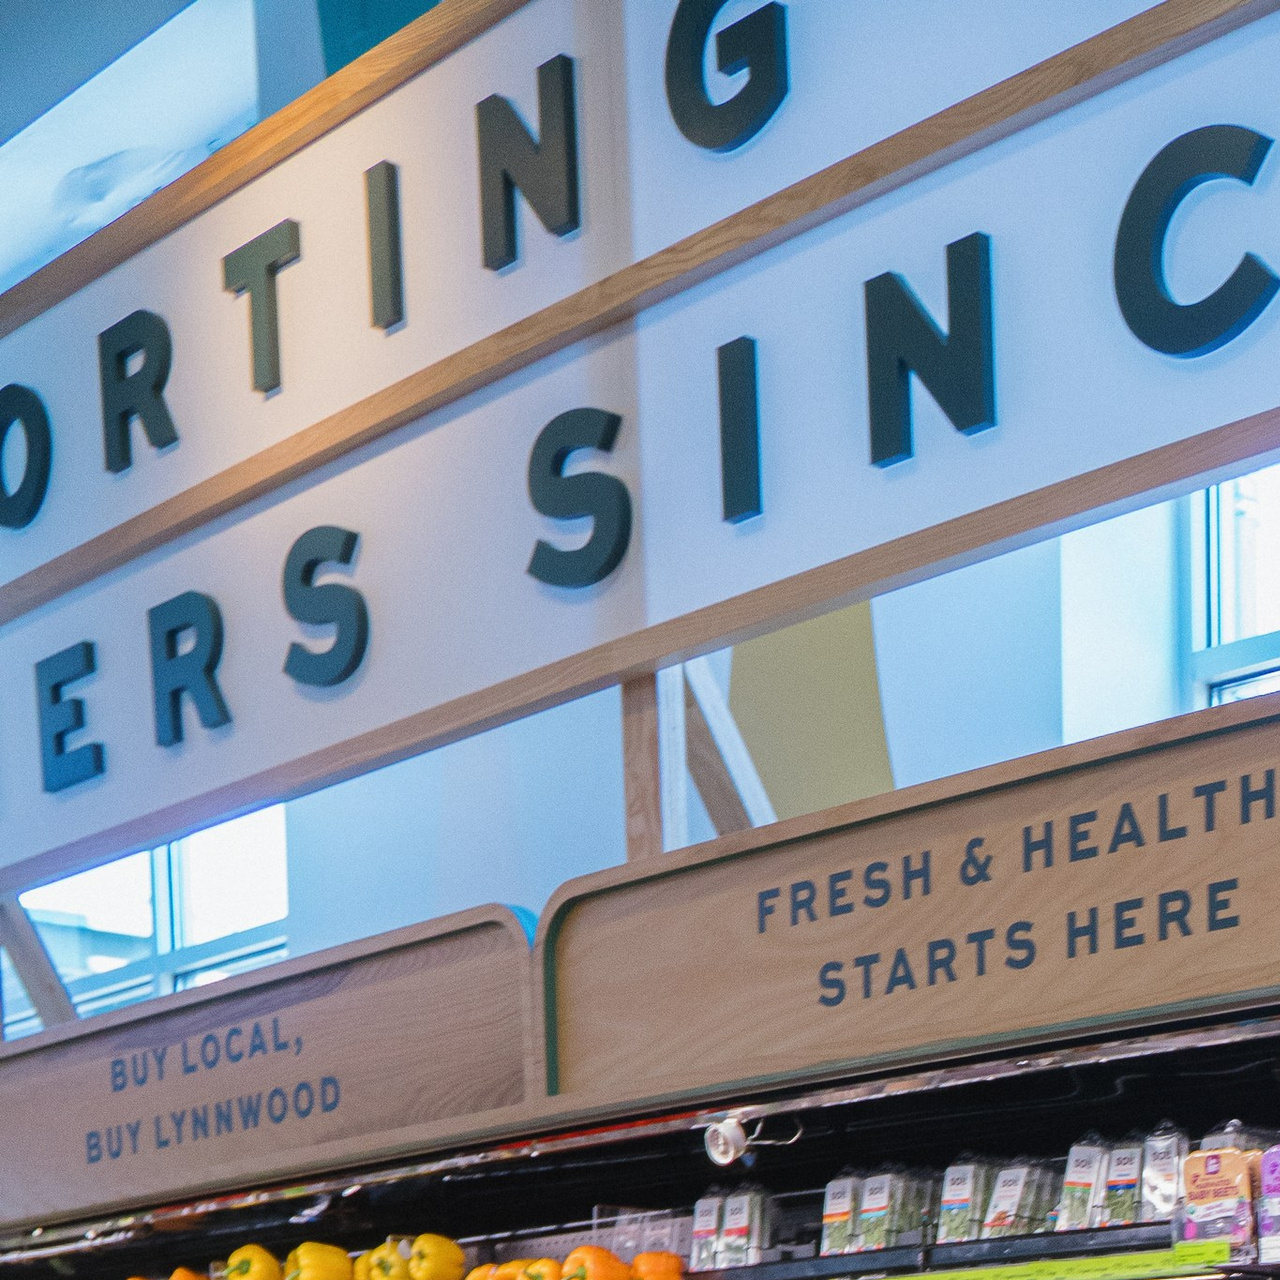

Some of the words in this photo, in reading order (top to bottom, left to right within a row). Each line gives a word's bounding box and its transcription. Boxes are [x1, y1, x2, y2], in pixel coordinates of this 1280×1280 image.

[34, 524, 370, 794] ERS
[757, 850, 931, 934] FRESH
[960, 838, 993, 887] &
[818, 921, 1037, 1007] STARTS
[1067, 878, 1241, 959] HERE
[110, 1047, 168, 1092] BUY
[182, 1016, 303, 1074] LOCAL,
[86, 1121, 141, 1164] BUY
[155, 1076, 342, 1148] LYNNWOOD
